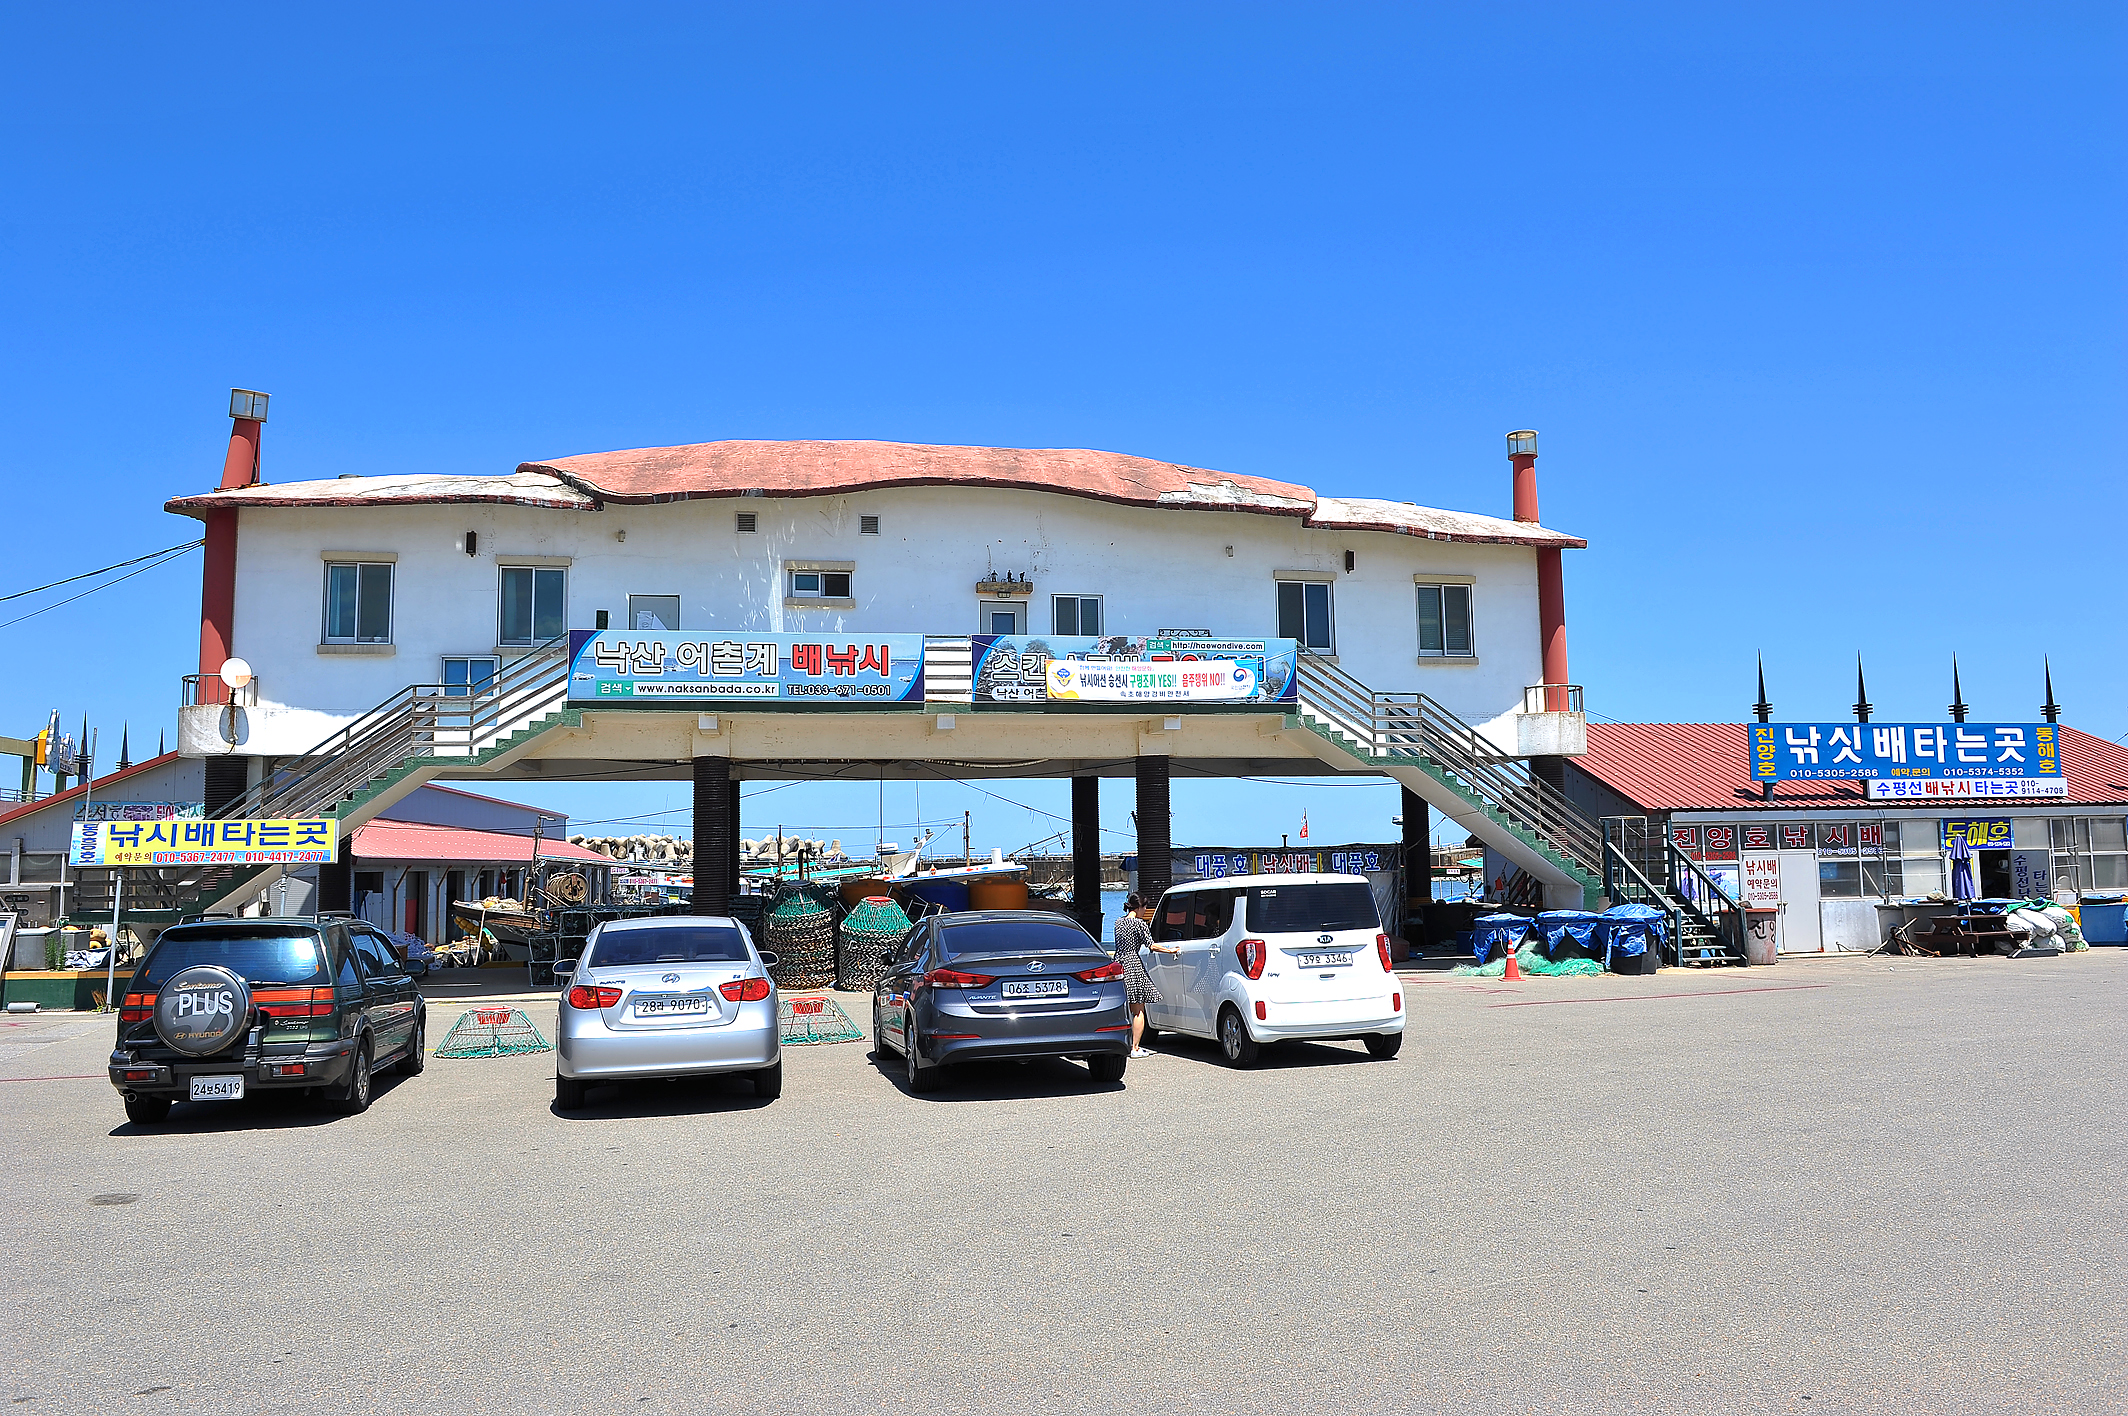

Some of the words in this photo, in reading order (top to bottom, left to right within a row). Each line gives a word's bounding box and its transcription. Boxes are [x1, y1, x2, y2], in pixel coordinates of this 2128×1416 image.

[1172, 641, 1263, 650] http://haewondive.com
[595, 641, 666, 676] 낙산
[676, 640, 777, 676] 어촌계
[791, 643, 890, 677] 배낚시
[1079, 673, 1107, 688] 낚시어선
[1108, 673, 1128, 689] 승선시
[1129, 673, 1156, 688] 구명조끼
[1157, 673, 1177, 688] YES!!
[1182, 673, 1208, 688] 음주행위
[1209, 672, 1226, 687] NO!!
[600, 682, 623, 695] 검색
[637, 683, 776, 695] www.naksanbada.co.kr
[787, 684, 891, 696] TEL:033-671-0501
[996, 688, 1020, 699] 낙산
[1754, 727, 1777, 777] 진양호
[2035, 727, 2058, 774] 동해호
[1789, 769, 1879, 778] 010-5305-2586
[1943, 767, 2024, 777] 010-5374-5352
[1875, 780, 1923, 796] 수평선
[1974, 780, 2019, 795] 타는곳
[2020, 780, 2040, 788] 010-
[2020, 787, 2064, 795] 9114-4708
[1945, 821, 2010, 848] 동해호
[114, 852, 152, 862] 예약문의
[156, 851, 235, 863] 010-5367-2477
[245, 851, 324, 862] 010-4417-2477
[1332, 852, 1381, 876] 대풍호
[1745, 859, 1777, 876] 낚시배
[1747, 878, 1778, 889] 예약문의
[1303, 954, 1321, 965] 39호
[1325, 953, 1348, 964] 3346
[174, 981, 227, 992] Santamo
[1034, 981, 1063, 993] 5378
[178, 990, 234, 1017] PLUS
[642, 1000, 665, 1013] 28라
[670, 998, 701, 1011] 9070
[188, 1031, 224, 1039] HYUNDAI
[193, 1081, 241, 1096] 24보5419
